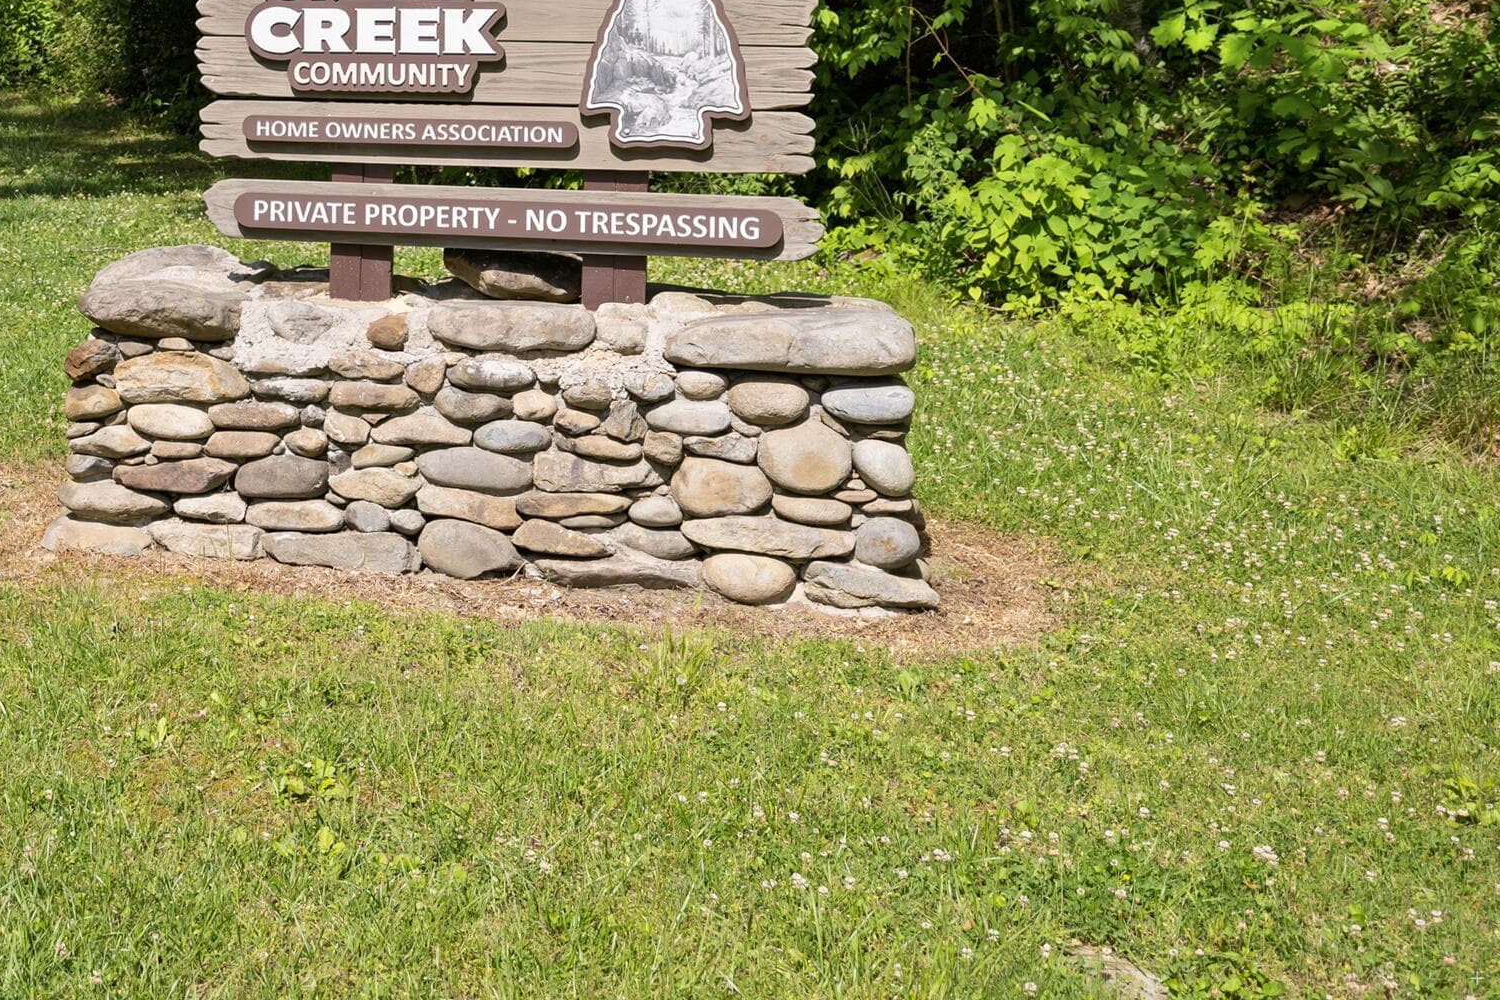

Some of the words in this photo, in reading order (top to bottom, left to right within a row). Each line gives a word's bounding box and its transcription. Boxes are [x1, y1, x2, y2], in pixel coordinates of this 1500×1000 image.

[251, 6, 498, 55] CREEK
[293, 62, 470, 86] COMMUNITY
[256, 121, 318, 138] HOME
[325, 122, 415, 140] OWNERS
[422, 123, 564, 144] ASSOCIATION
[254, 201, 356, 225] PRIVATE
[365, 205, 500, 230] PROPERTY
[526, 210, 567, 233] NO
[575, 211, 760, 240] TRESPASSING
